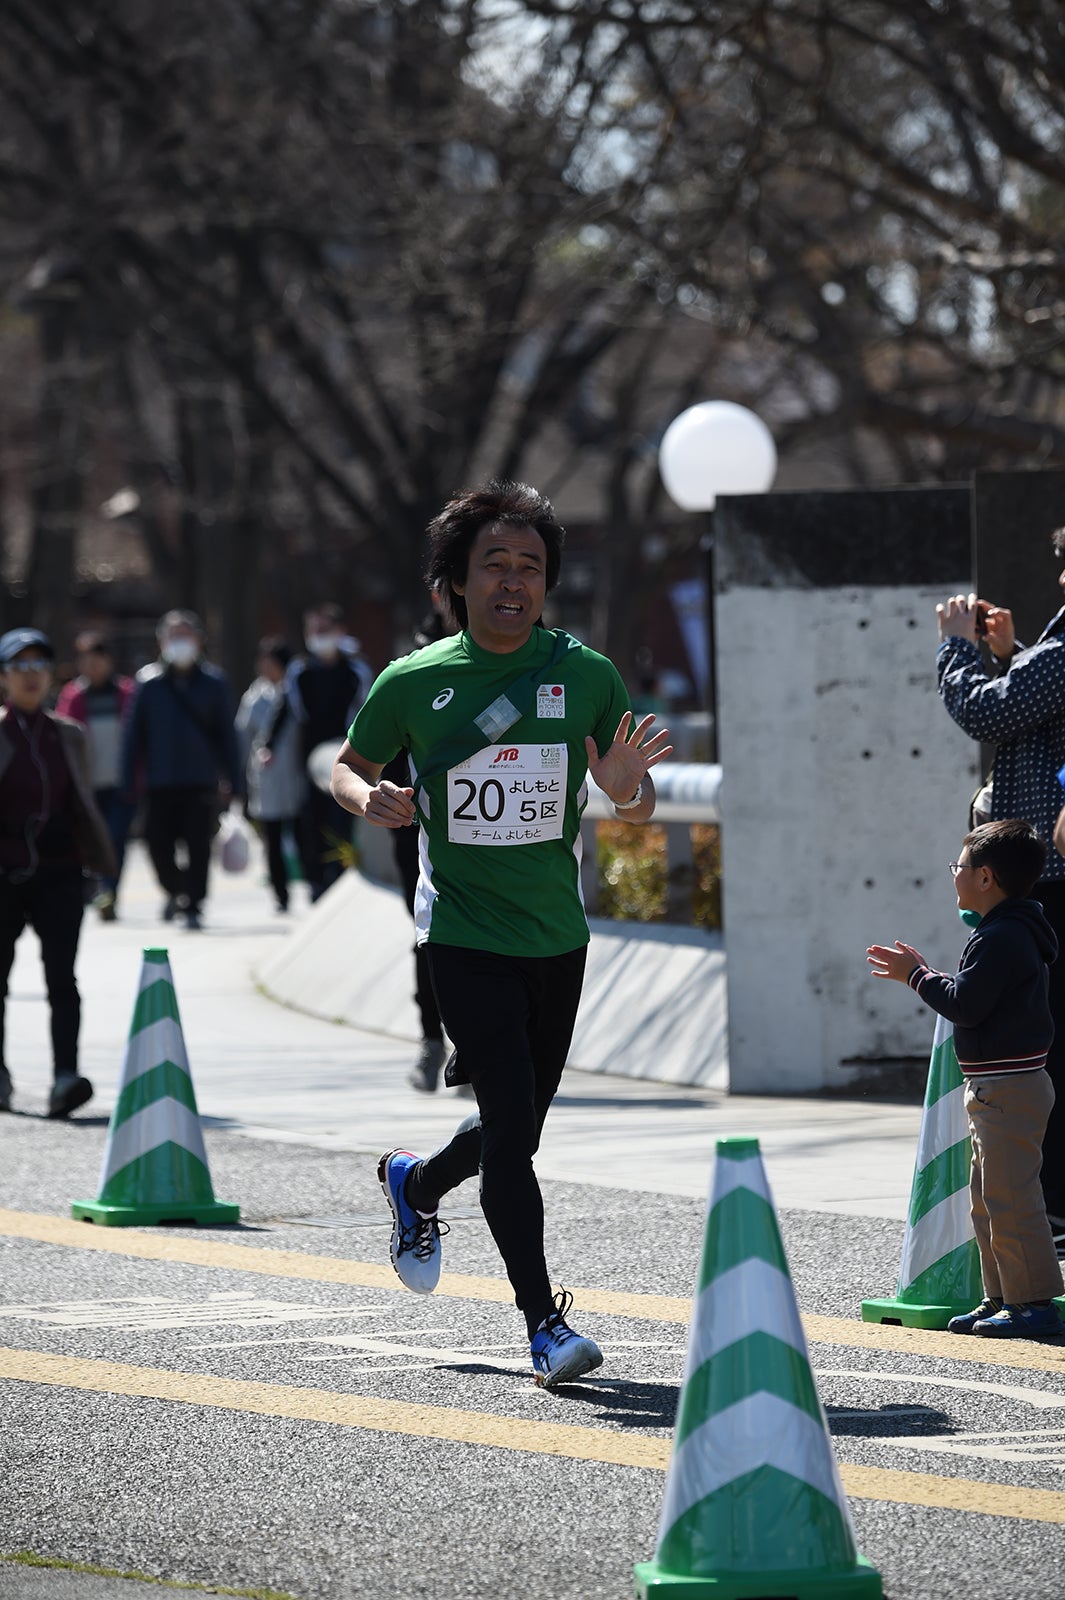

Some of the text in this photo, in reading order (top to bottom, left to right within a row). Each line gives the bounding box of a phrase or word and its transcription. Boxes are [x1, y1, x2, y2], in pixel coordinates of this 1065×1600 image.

[493, 748, 519, 763] JTB
[509, 779, 560, 794] よしもと
[453, 779, 505, 822] 20
[519, 800, 558, 822] 5区
[471, 829, 542, 841] チーム よしもと
